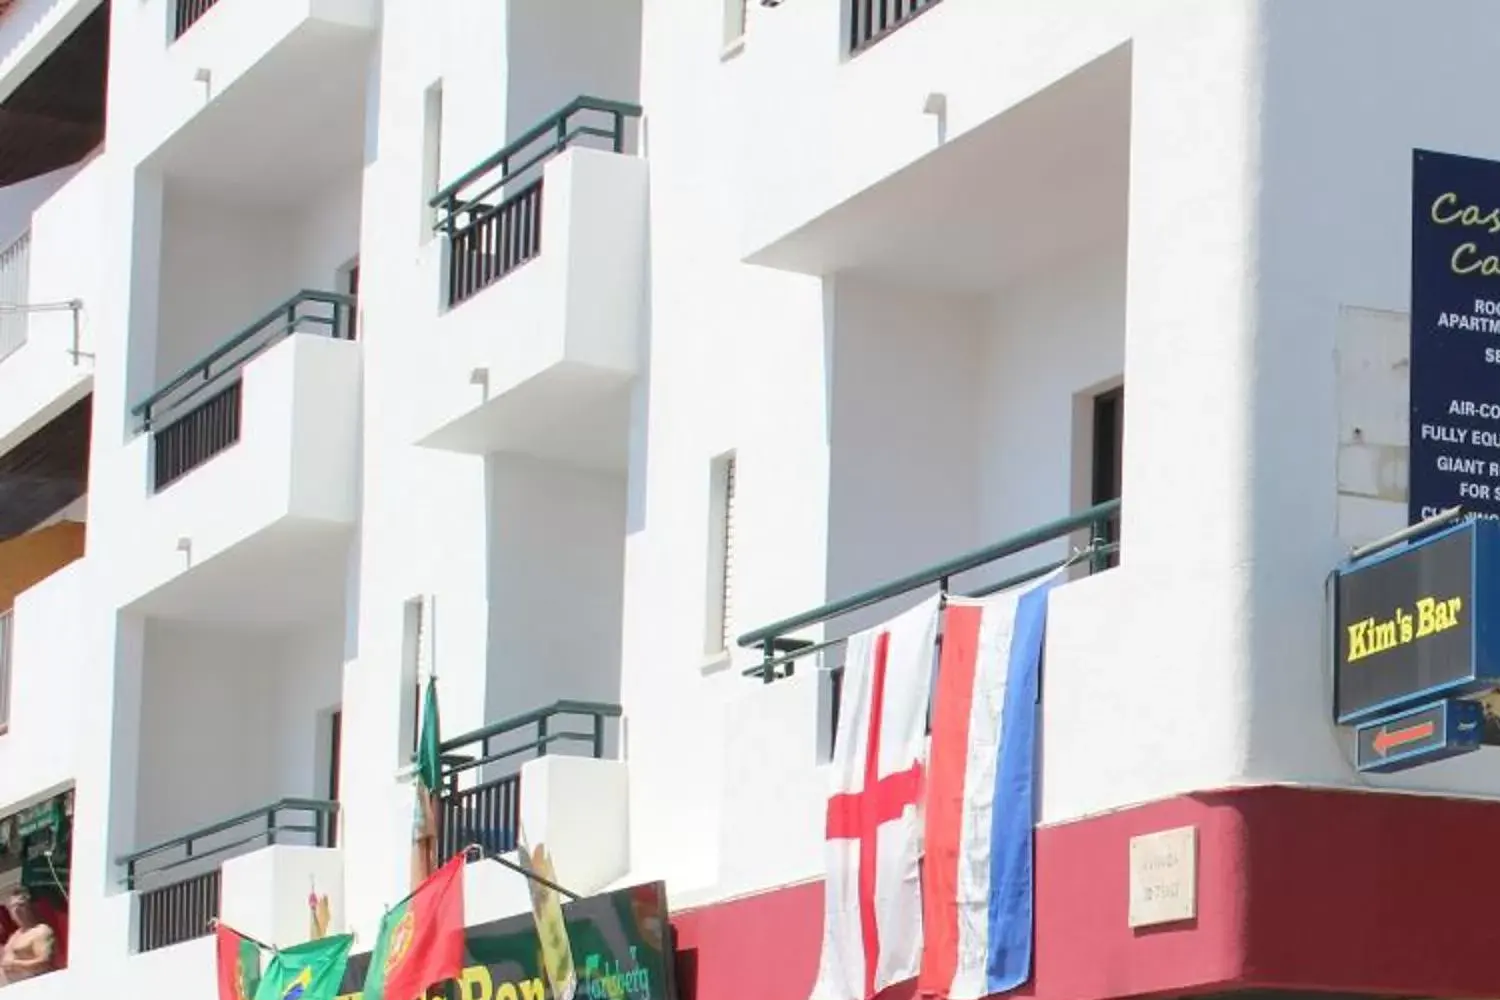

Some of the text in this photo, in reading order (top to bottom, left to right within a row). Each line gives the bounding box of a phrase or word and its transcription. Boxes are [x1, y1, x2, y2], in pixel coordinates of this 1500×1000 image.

[1421, 424, 1468, 443] FULLY
[1437, 456, 1485, 476] GIANT
[1459, 483, 1489, 499] FOR
[1347, 596, 1462, 662] Kim's Bar
